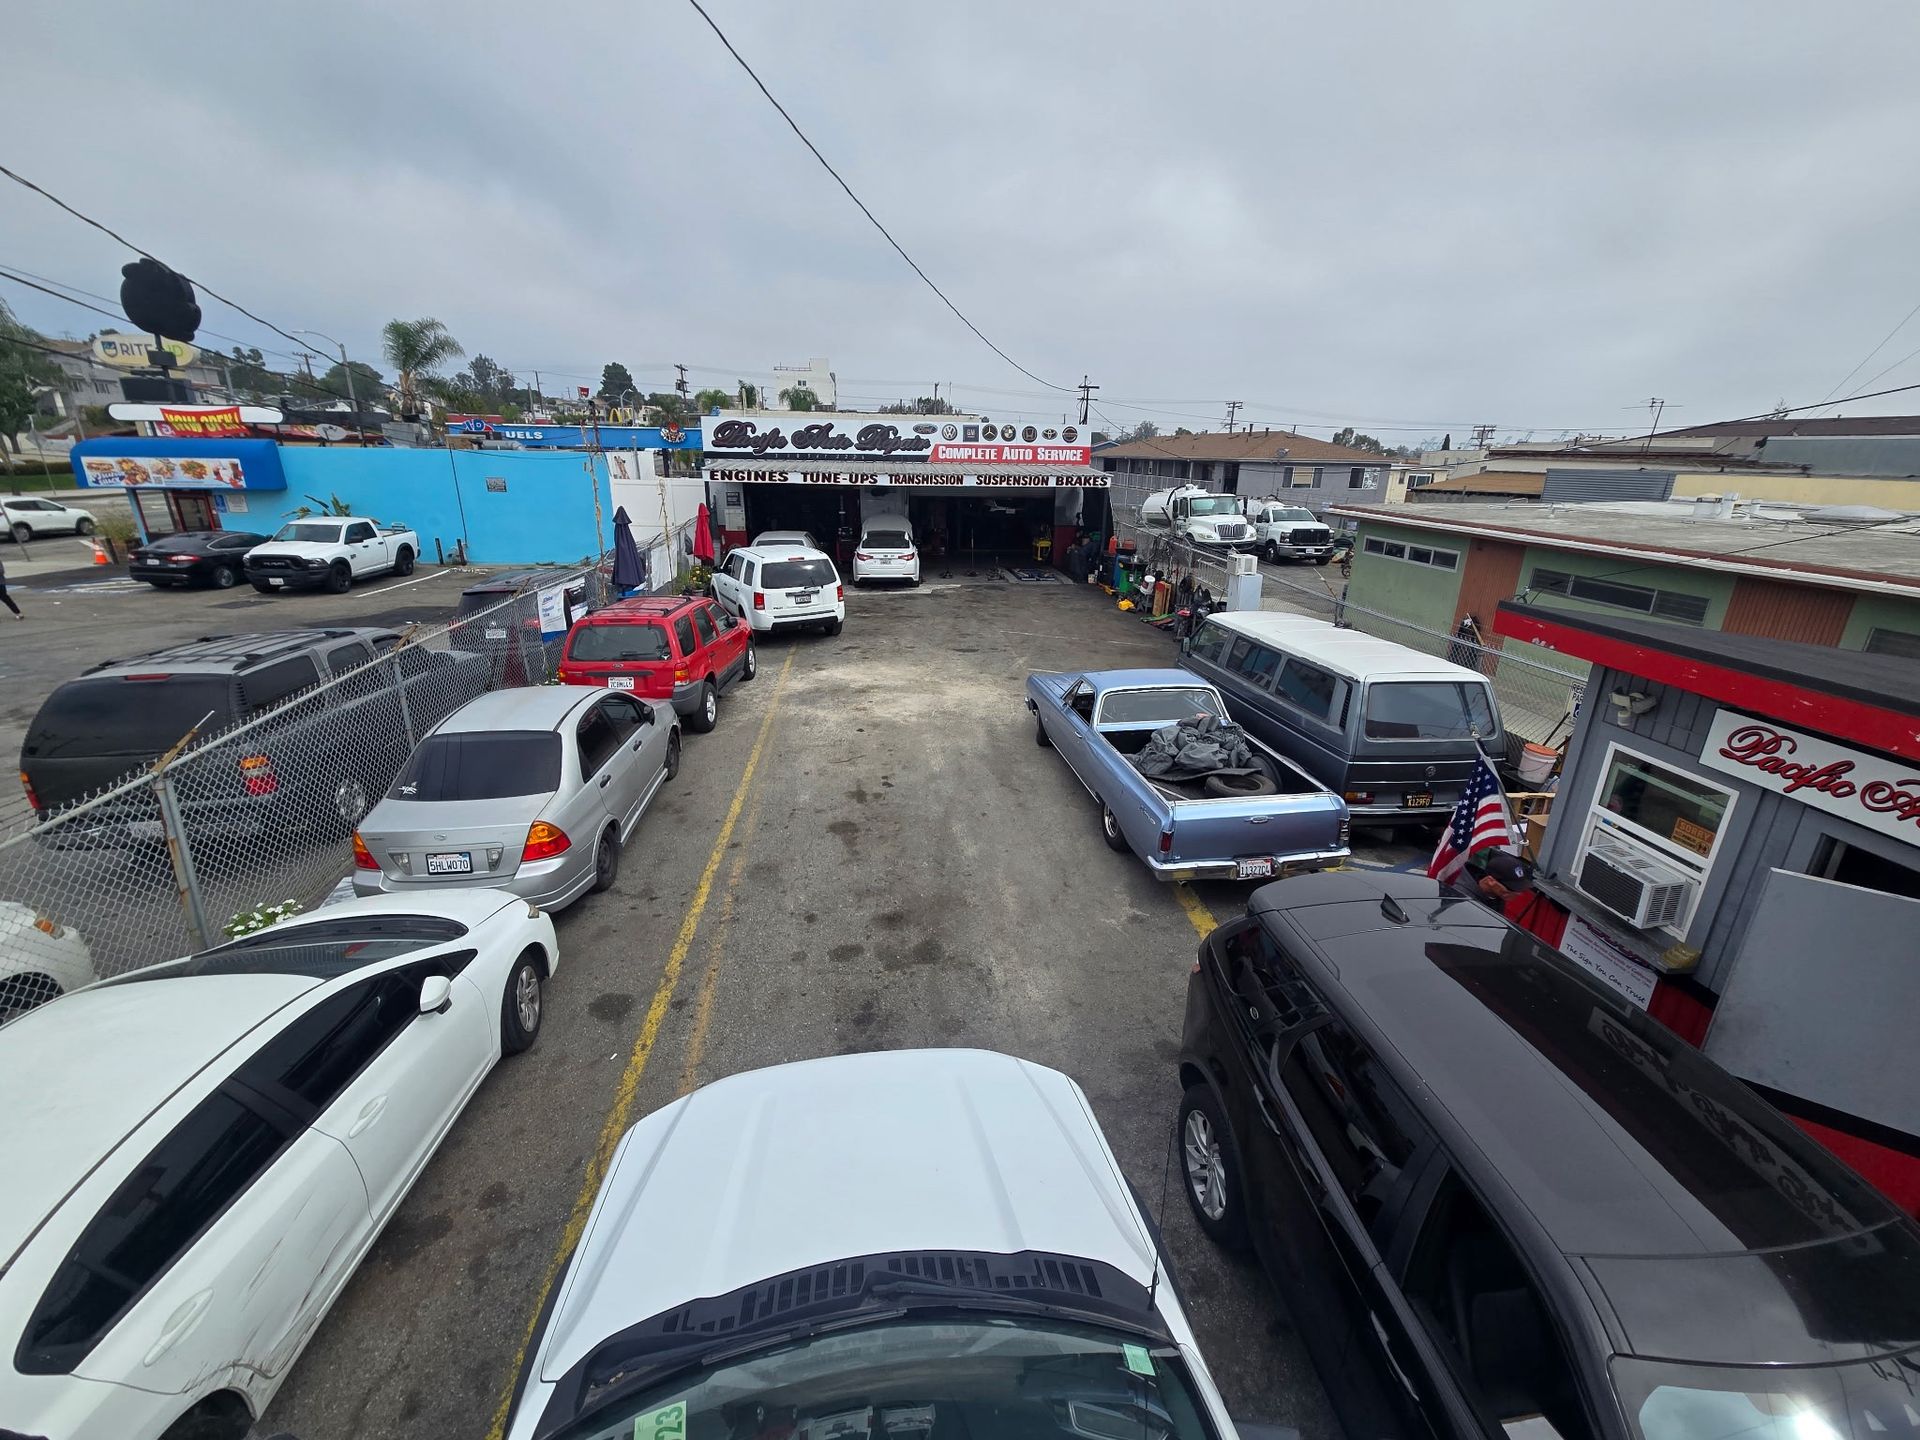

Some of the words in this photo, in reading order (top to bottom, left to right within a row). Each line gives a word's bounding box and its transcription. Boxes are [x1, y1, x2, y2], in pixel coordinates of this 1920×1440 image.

[505, 431, 543, 439] UELS
[791, 422, 853, 450] Auto
[854, 423, 931, 456] Repair
[938, 446, 997, 460] COMPLETE
[1002, 446, 1032, 461] AUTO
[1037, 448, 1083, 461] SERVICE
[709, 470, 789, 483] ENGINES
[802, 472, 878, 485] TUNE-UPS
[888, 473, 964, 485] TRANSMISSION
[976, 475, 1049, 486] SUSPENSION
[1055, 475, 1108, 487] BRAKES
[1719, 725, 1856, 798] Pacific
[430, 860, 469, 871] 5HLW070
[1566, 943, 1577, 956] The
[1579, 952, 1594, 966] Sign
[1595, 963, 1607, 977] You
[1609, 974, 1622, 988] Can
[1625, 985, 1647, 1004] Trust
